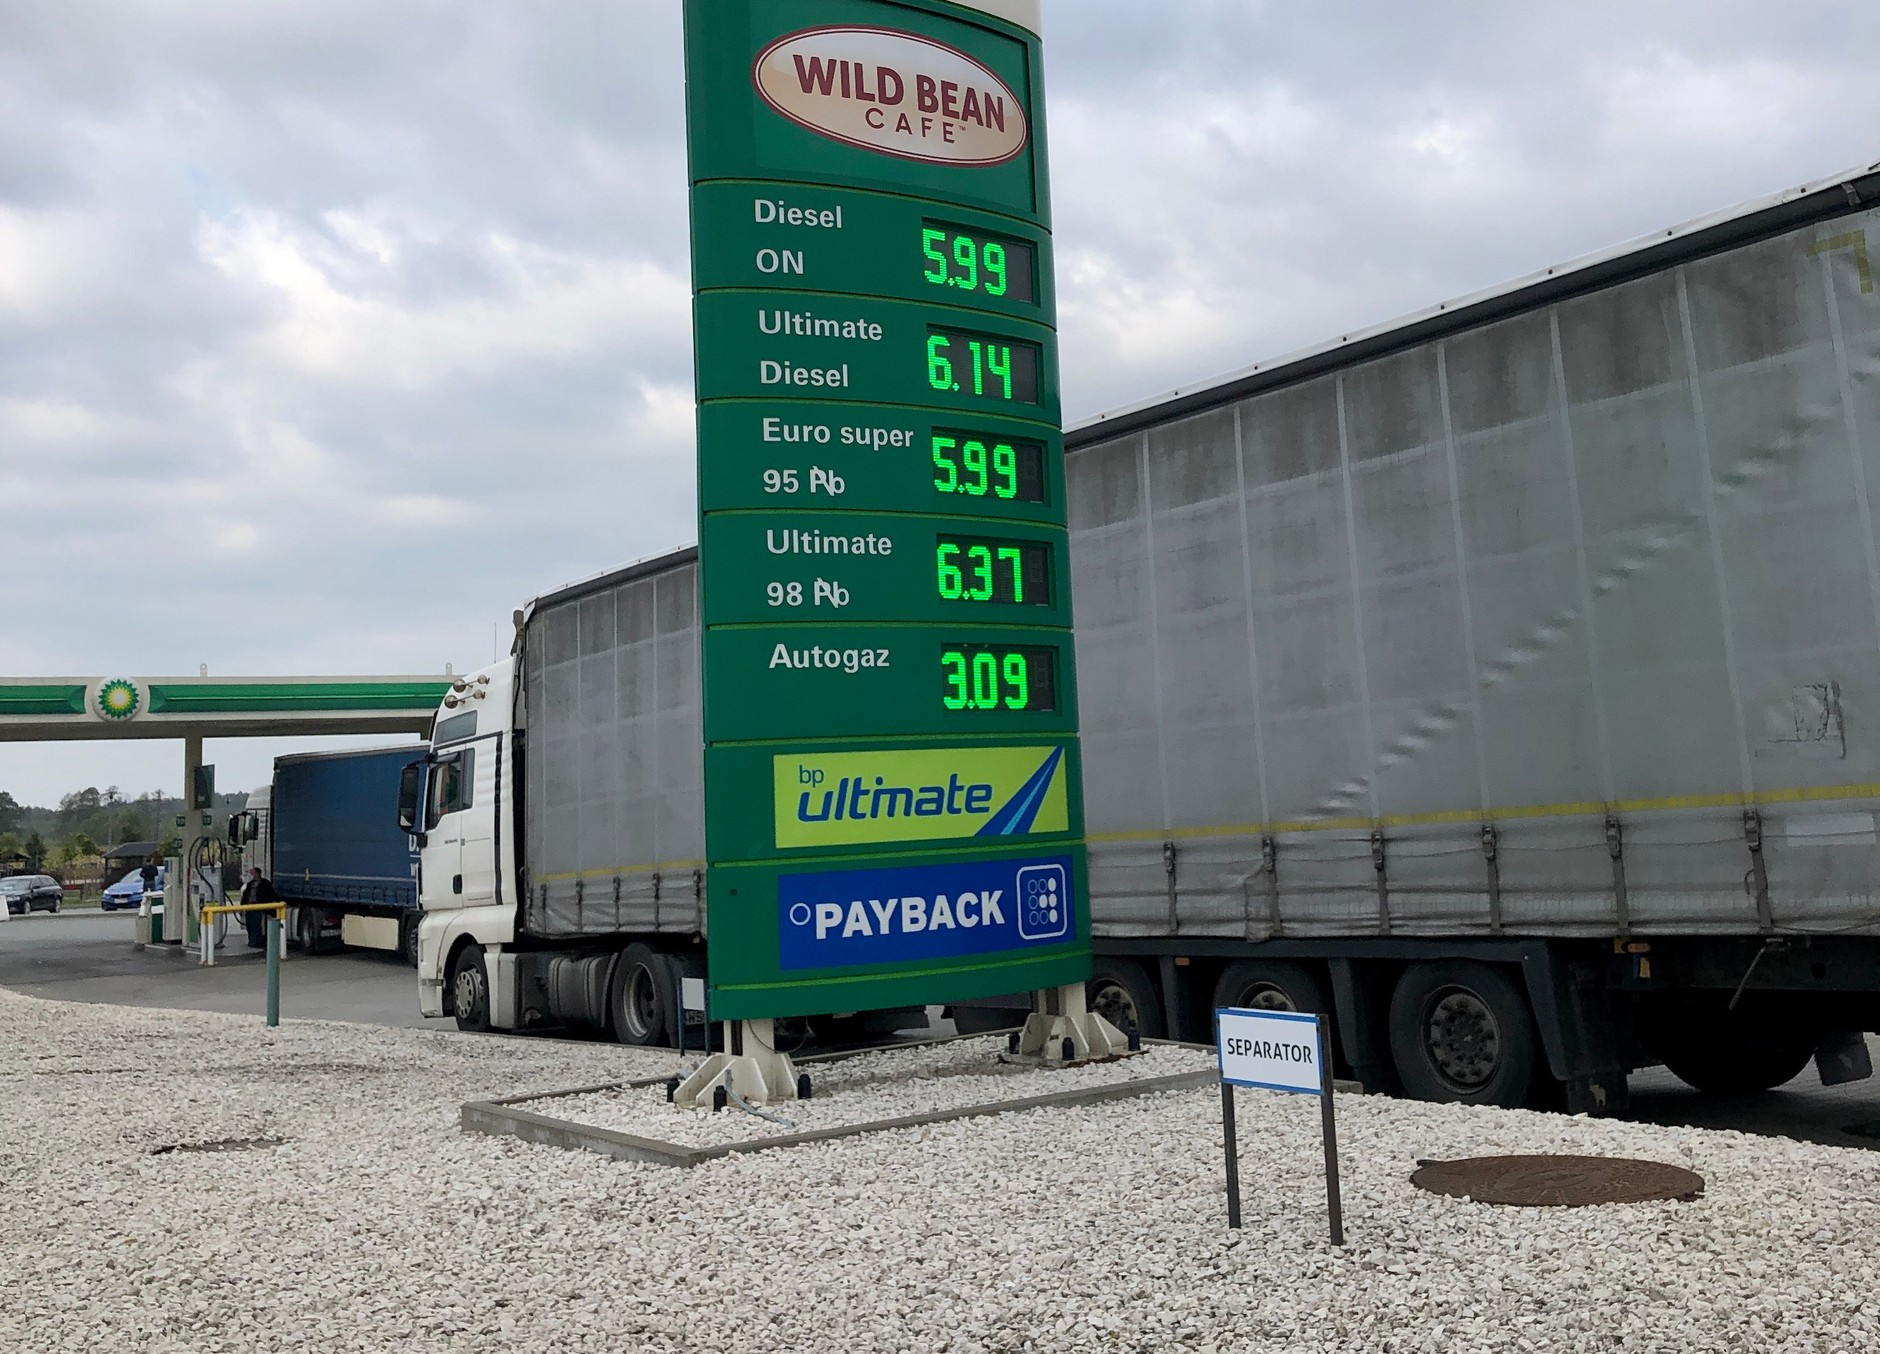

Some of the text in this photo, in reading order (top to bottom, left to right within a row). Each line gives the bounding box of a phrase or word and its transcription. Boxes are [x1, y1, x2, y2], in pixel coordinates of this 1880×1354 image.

[793, 54, 1005, 133] WILD BEAN
[865, 108, 955, 144] CAFE
[755, 199, 843, 229] Diesel
[756, 249, 804, 275] ON
[922, 228, 1007, 296] 5.99
[759, 310, 883, 341] Ultimate
[760, 361, 849, 388] Diesel
[927, 335, 1012, 400] 6.14
[763, 418, 914, 451] Euro super
[763, 469, 799, 494] 95
[932, 436, 1018, 499] 5.99
[766, 529, 892, 555] Ultimate
[936, 543, 1023, 603] 6.37
[767, 582, 803, 607] 98
[769, 643, 890, 674] Autogaz
[941, 651, 1028, 710] 3.09
[799, 765, 825, 786] bp
[797, 773, 993, 823] ultimate
[815, 890, 1005, 940] PAYBACK
[1227, 1037, 1313, 1064] SEPARATOR
